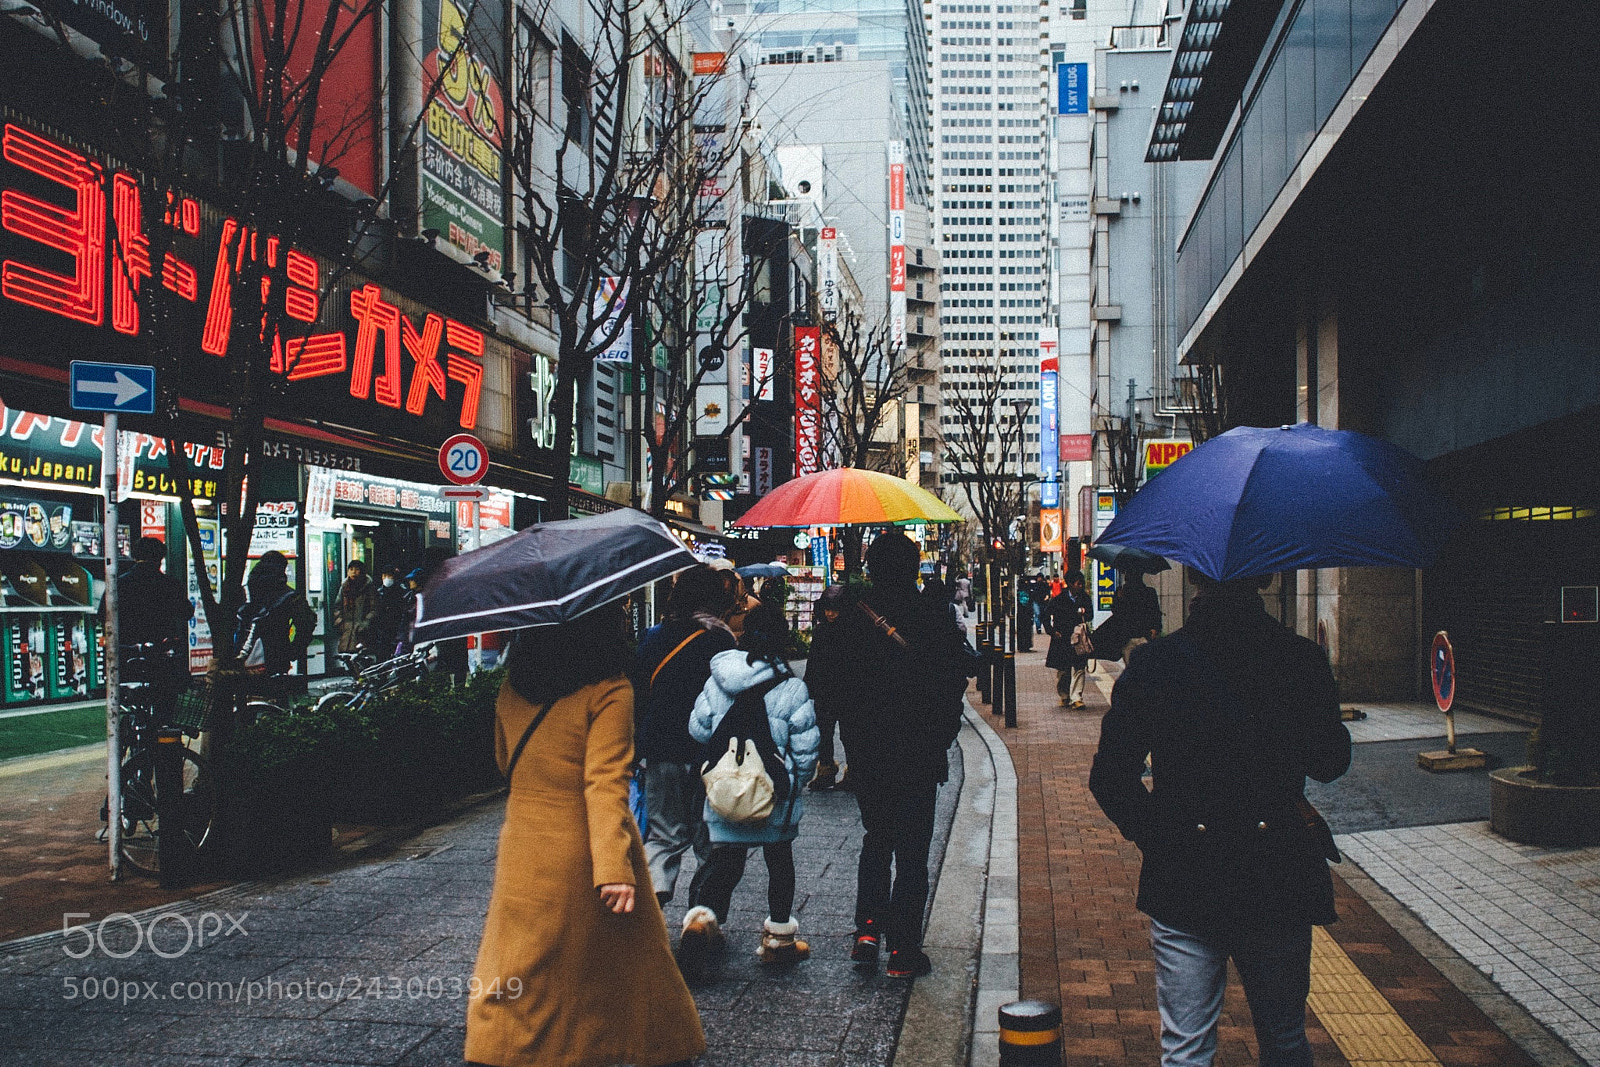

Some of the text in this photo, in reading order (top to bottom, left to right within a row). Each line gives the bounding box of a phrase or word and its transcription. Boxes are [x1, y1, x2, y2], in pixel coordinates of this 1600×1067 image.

[1067, 64, 1078, 88] BLDG.
[1068, 90, 1078, 110] SKY
[824, 230, 835, 239] 5F
[1, 123, 485, 430] ヨドバシカメラ
[892, 251, 904, 285] リーブ21
[800, 335, 816, 400] カラオケ
[1043, 379, 1056, 410] AOKI
[450, 449, 478, 471] 20
